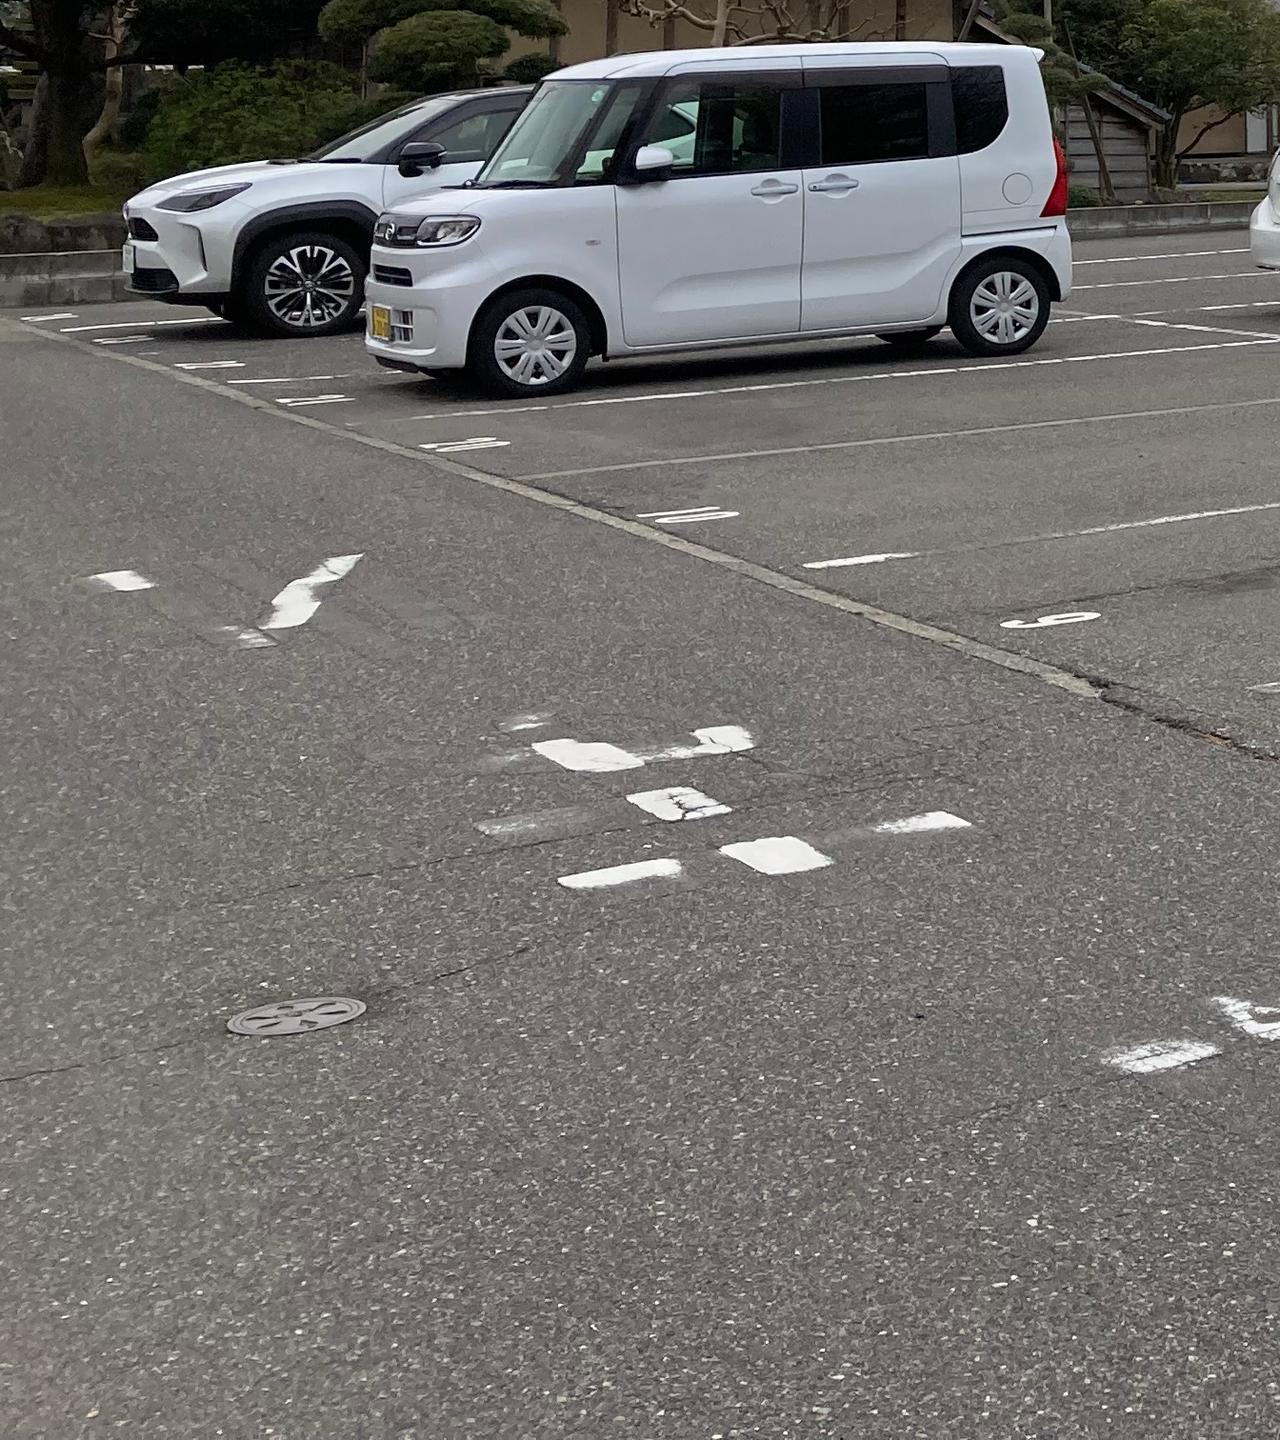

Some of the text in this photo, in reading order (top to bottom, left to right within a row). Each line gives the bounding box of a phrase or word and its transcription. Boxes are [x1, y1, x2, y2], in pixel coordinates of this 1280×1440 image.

[419, 437, 511, 453] 20
[636, 506, 739, 523] 10
[1000, 611, 1101, 629] 9
